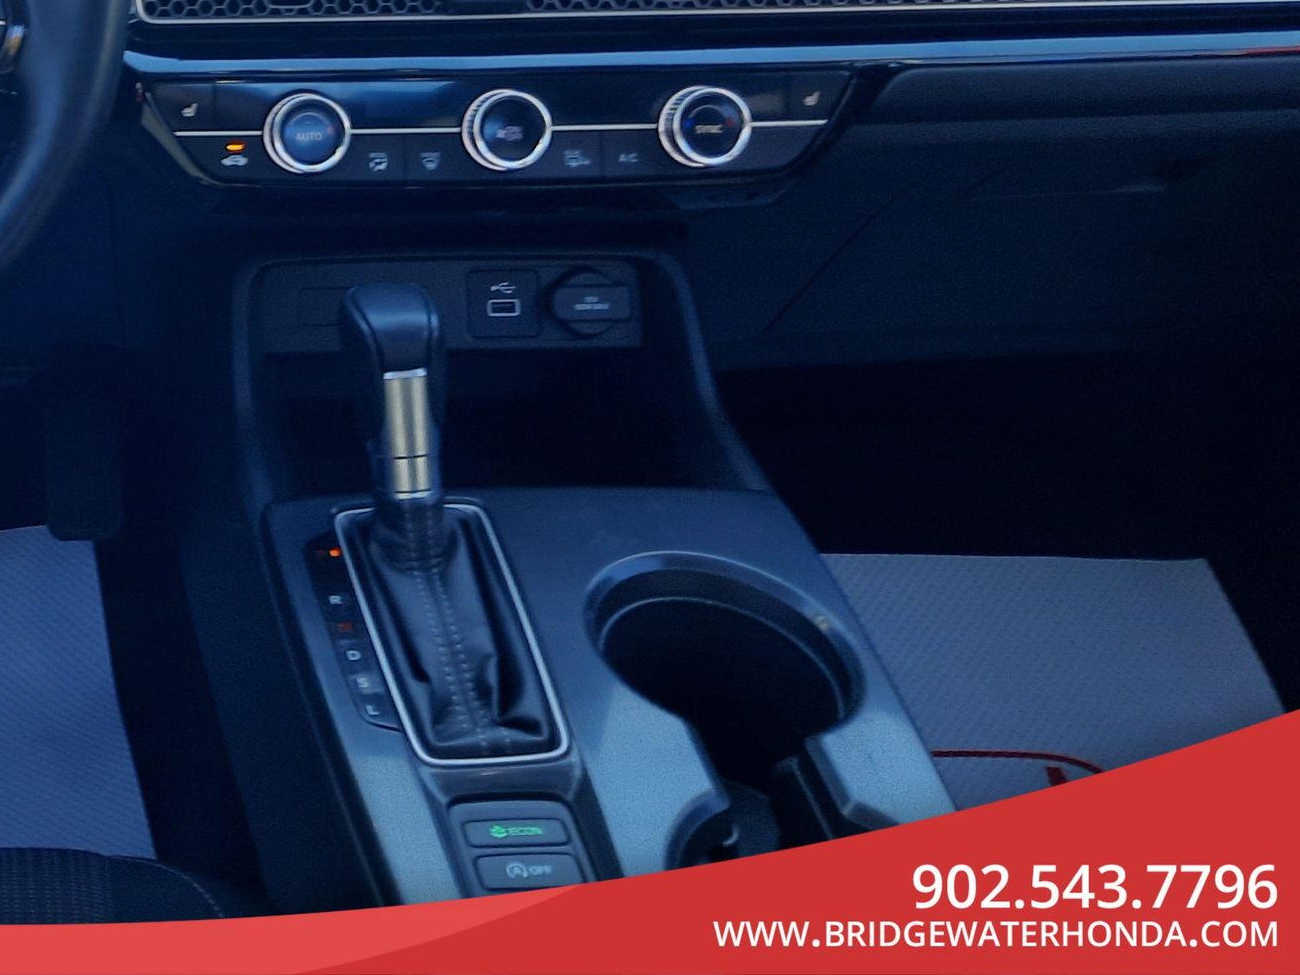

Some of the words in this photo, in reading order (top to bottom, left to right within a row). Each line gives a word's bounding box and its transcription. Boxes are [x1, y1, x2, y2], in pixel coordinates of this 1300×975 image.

[295, 131, 323, 142] AUTO
[329, 595, 342, 605] R
[346, 650, 361, 661] D
[356, 677, 369, 689] S
[366, 704, 380, 716] L
